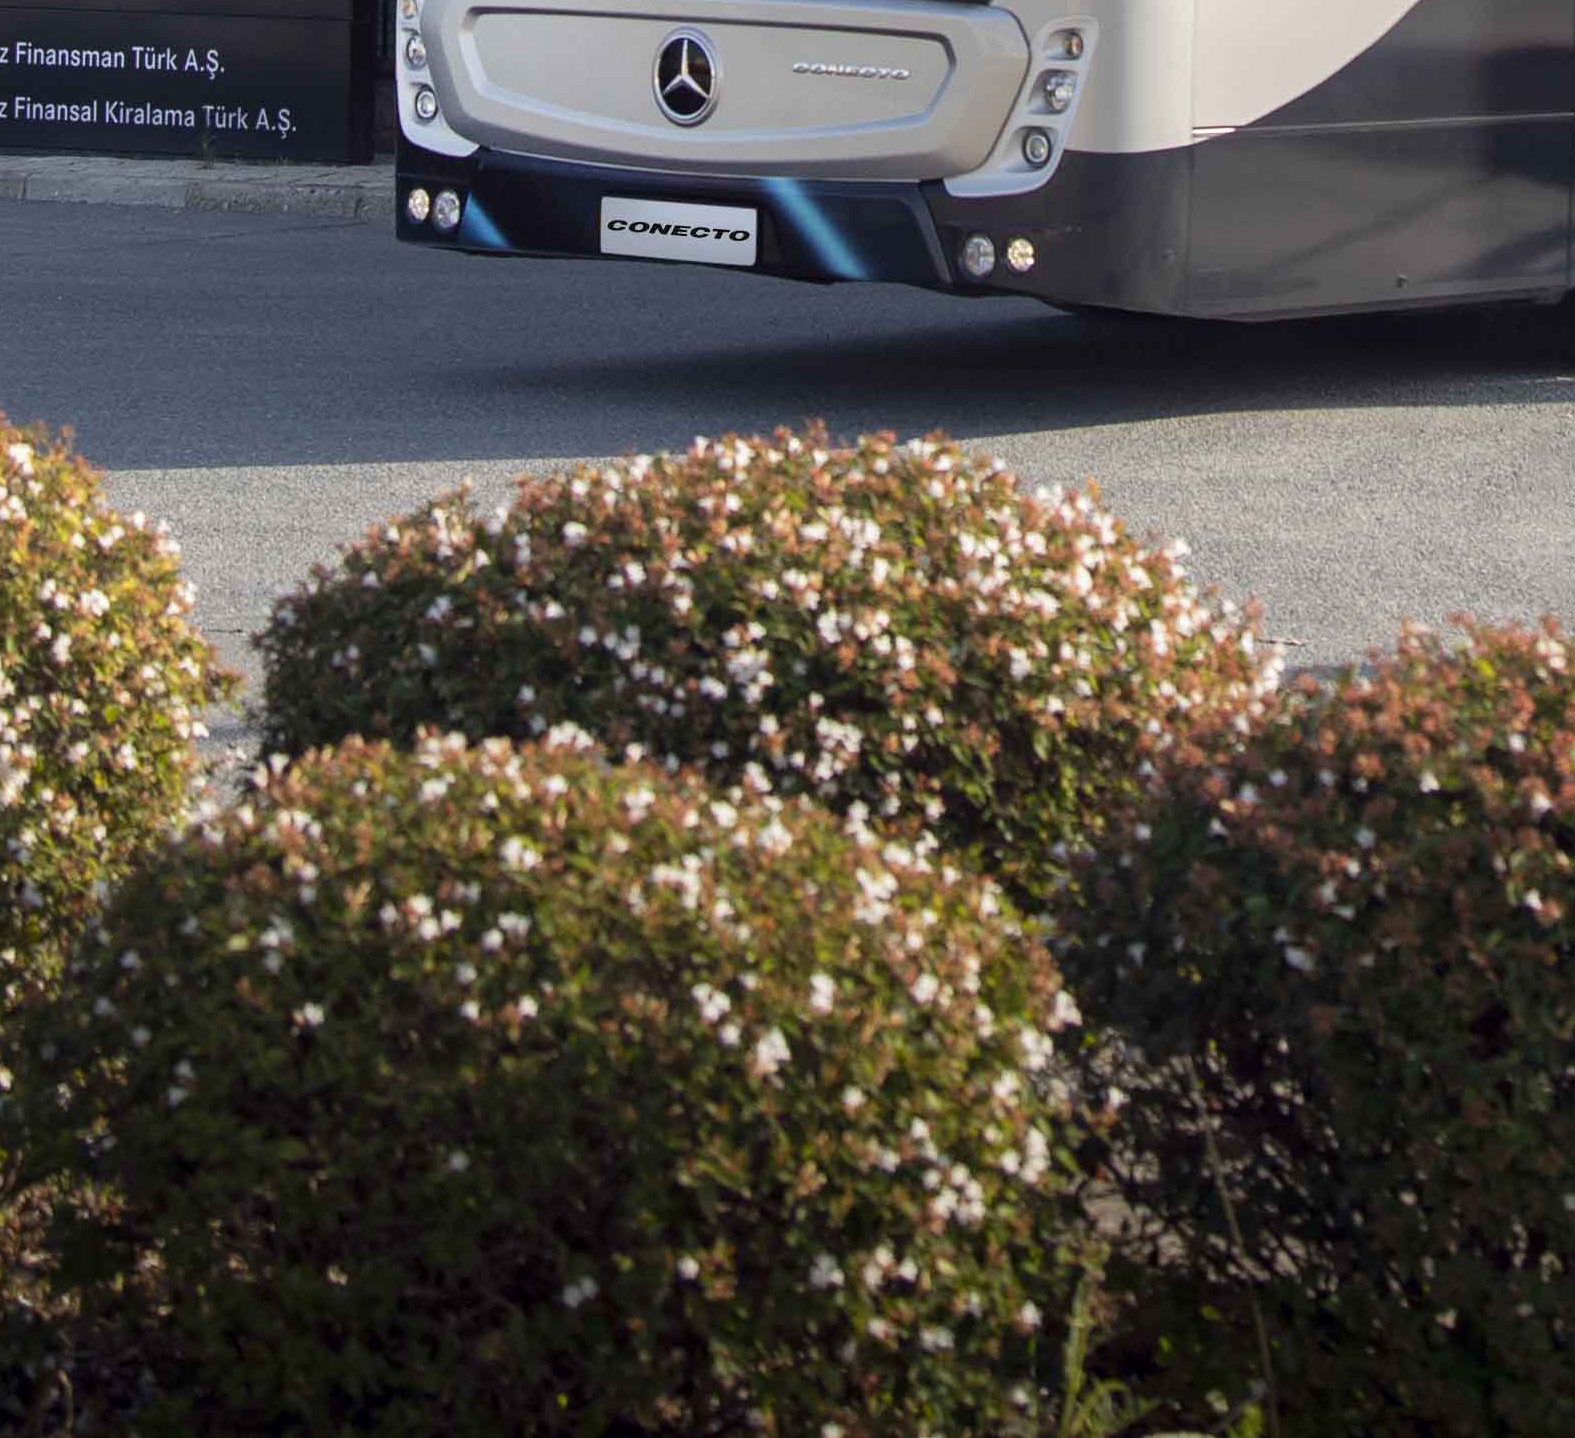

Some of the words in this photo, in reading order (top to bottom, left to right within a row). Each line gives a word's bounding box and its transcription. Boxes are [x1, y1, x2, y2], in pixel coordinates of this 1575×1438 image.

[16, 41, 126, 68] Finansman
[132, 46, 177, 70] Türk
[184, 48, 225, 80] A.Ş.
[792, 63, 910, 80] CONECTO
[14, 97, 98, 123] Finansal
[105, 101, 195, 127] Kiralama
[201, 104, 248, 130] Türk
[255, 108, 297, 139] A.Ş.
[607, 219, 750, 242] CONECTO
